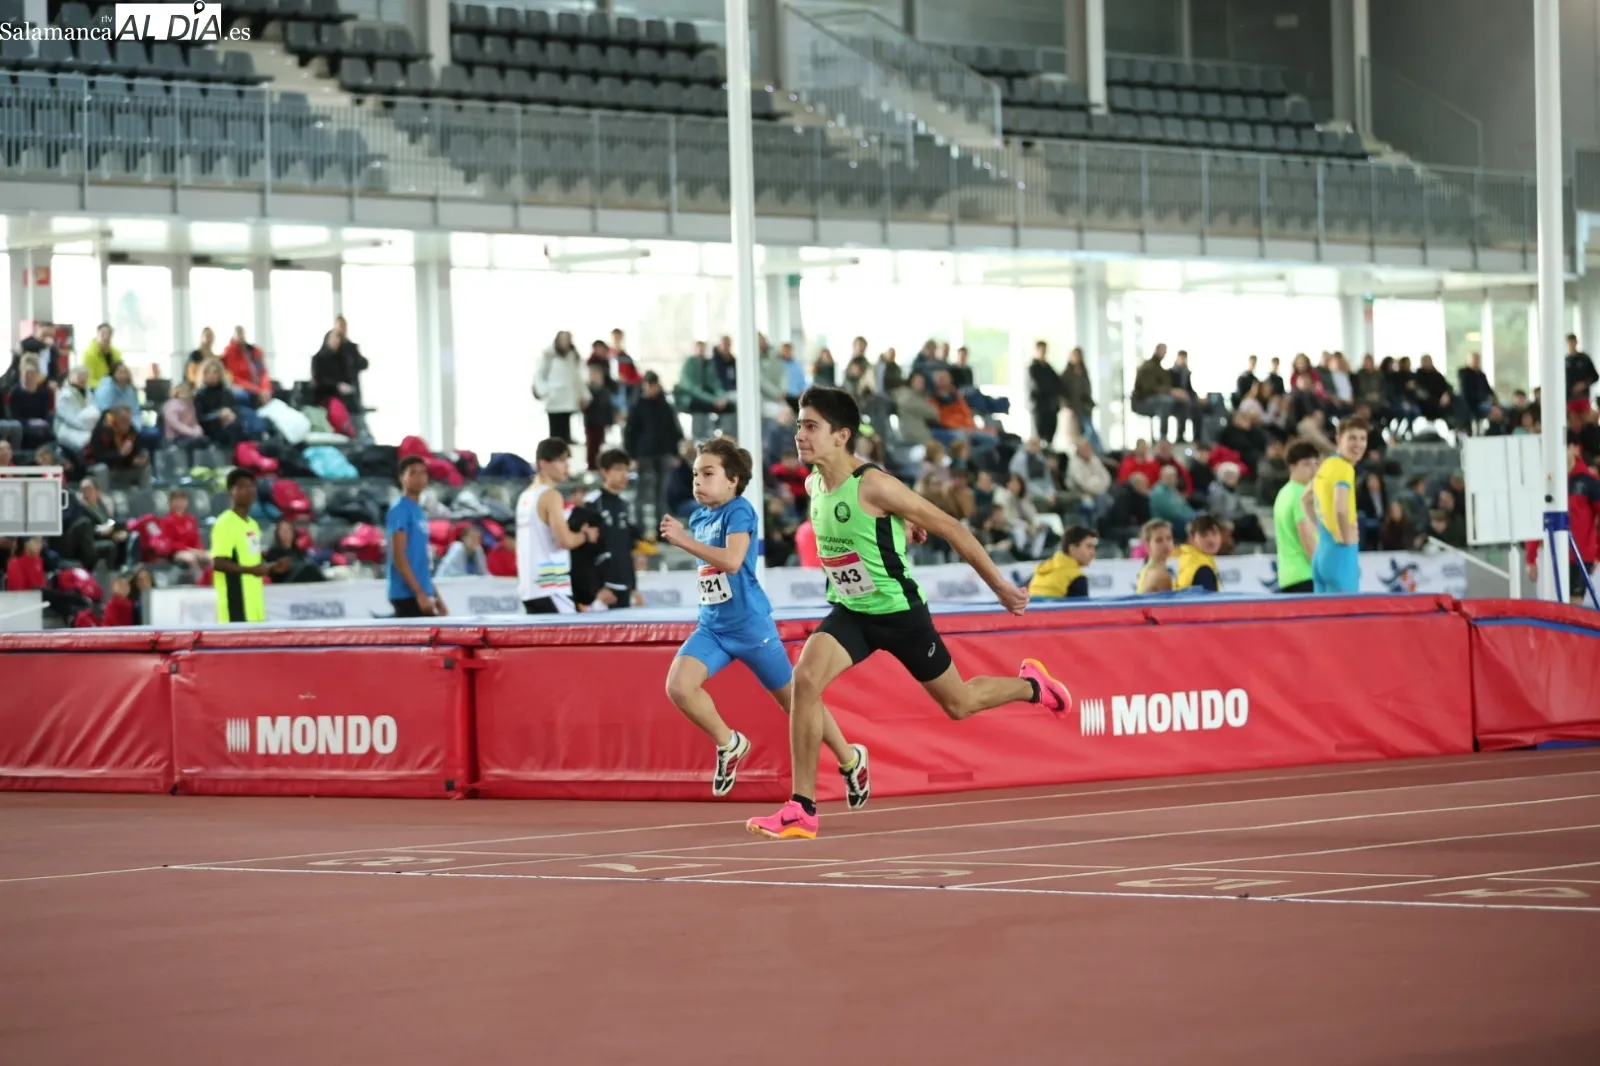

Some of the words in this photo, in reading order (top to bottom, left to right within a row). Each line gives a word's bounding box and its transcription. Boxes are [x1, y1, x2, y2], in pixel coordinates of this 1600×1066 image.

[832, 569, 862, 585] 543
[1111, 688, 1249, 736] MONDO
[256, 715, 398, 755] MONDO
